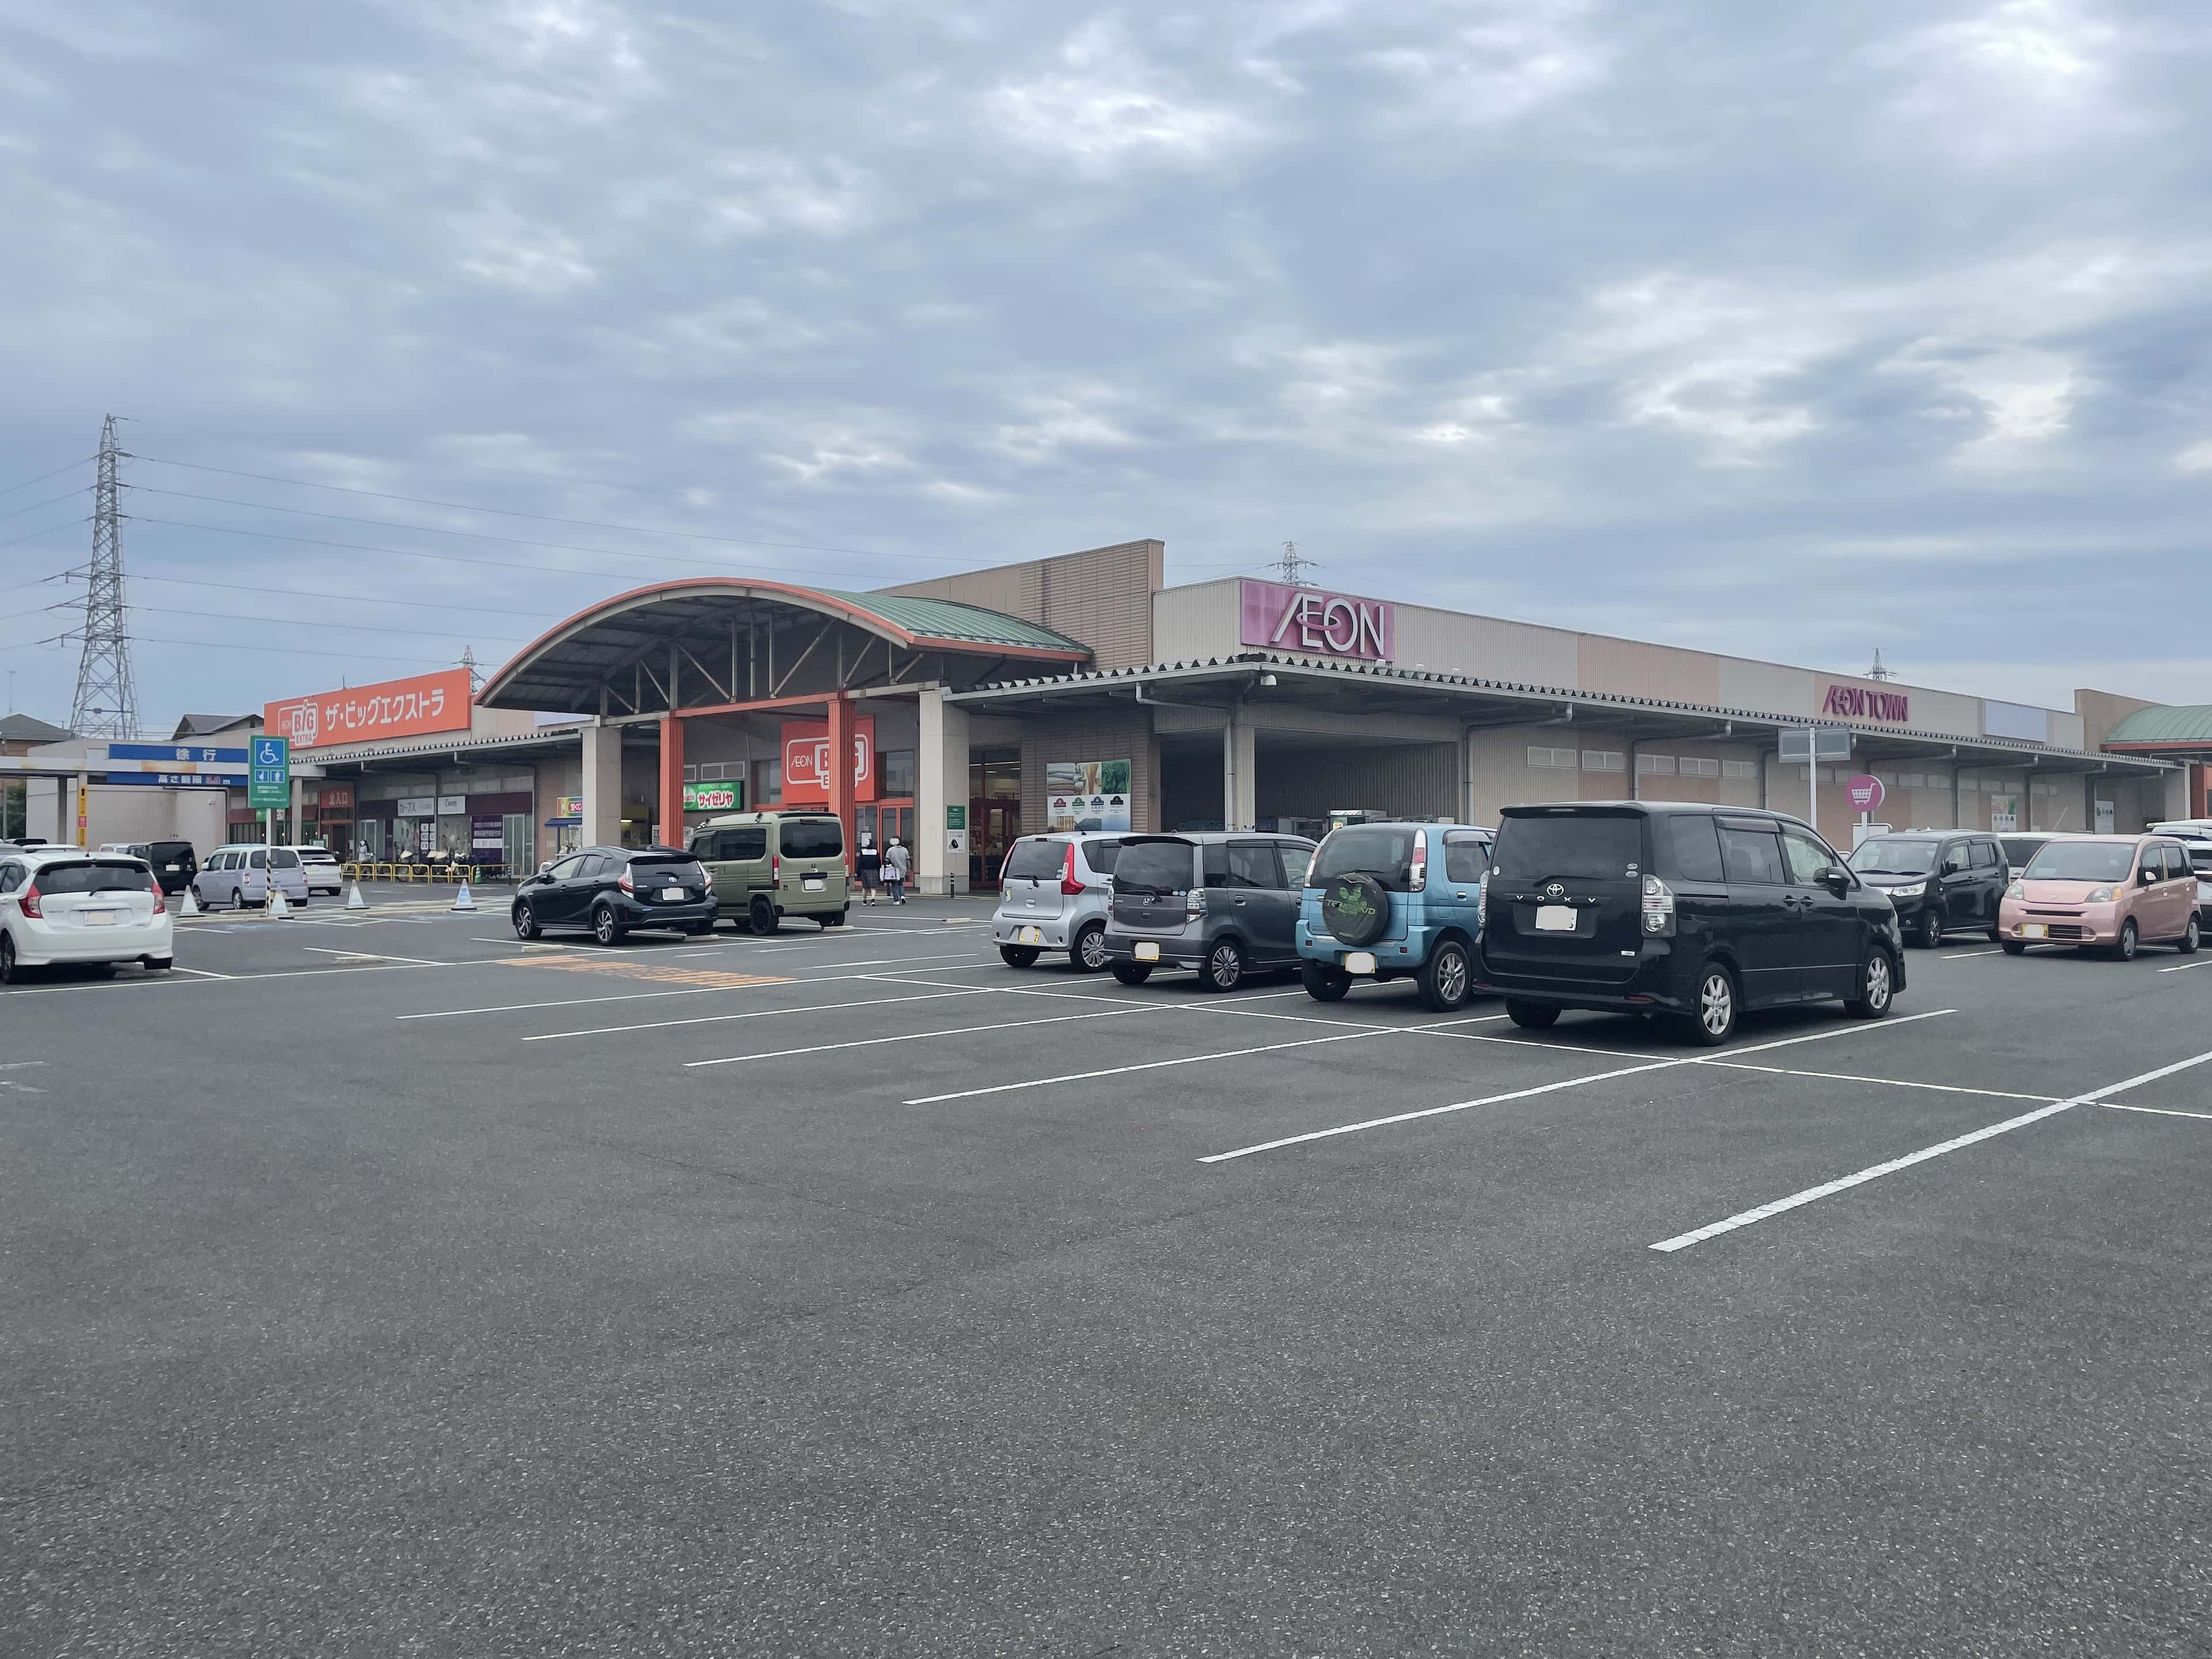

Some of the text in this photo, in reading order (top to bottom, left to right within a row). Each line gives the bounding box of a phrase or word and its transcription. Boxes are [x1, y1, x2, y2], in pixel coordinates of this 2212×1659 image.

[325, 689, 444, 731] ザ・ビッグエクストラ
[1866, 691, 1908, 722] TOWN
[294, 702, 314, 733] BIG
[296, 733, 313, 744] EXTRA
[176, 748, 216, 761] 徐行
[698, 792, 733, 806] サイゼリヤ
[1359, 906, 1376, 915] KID
